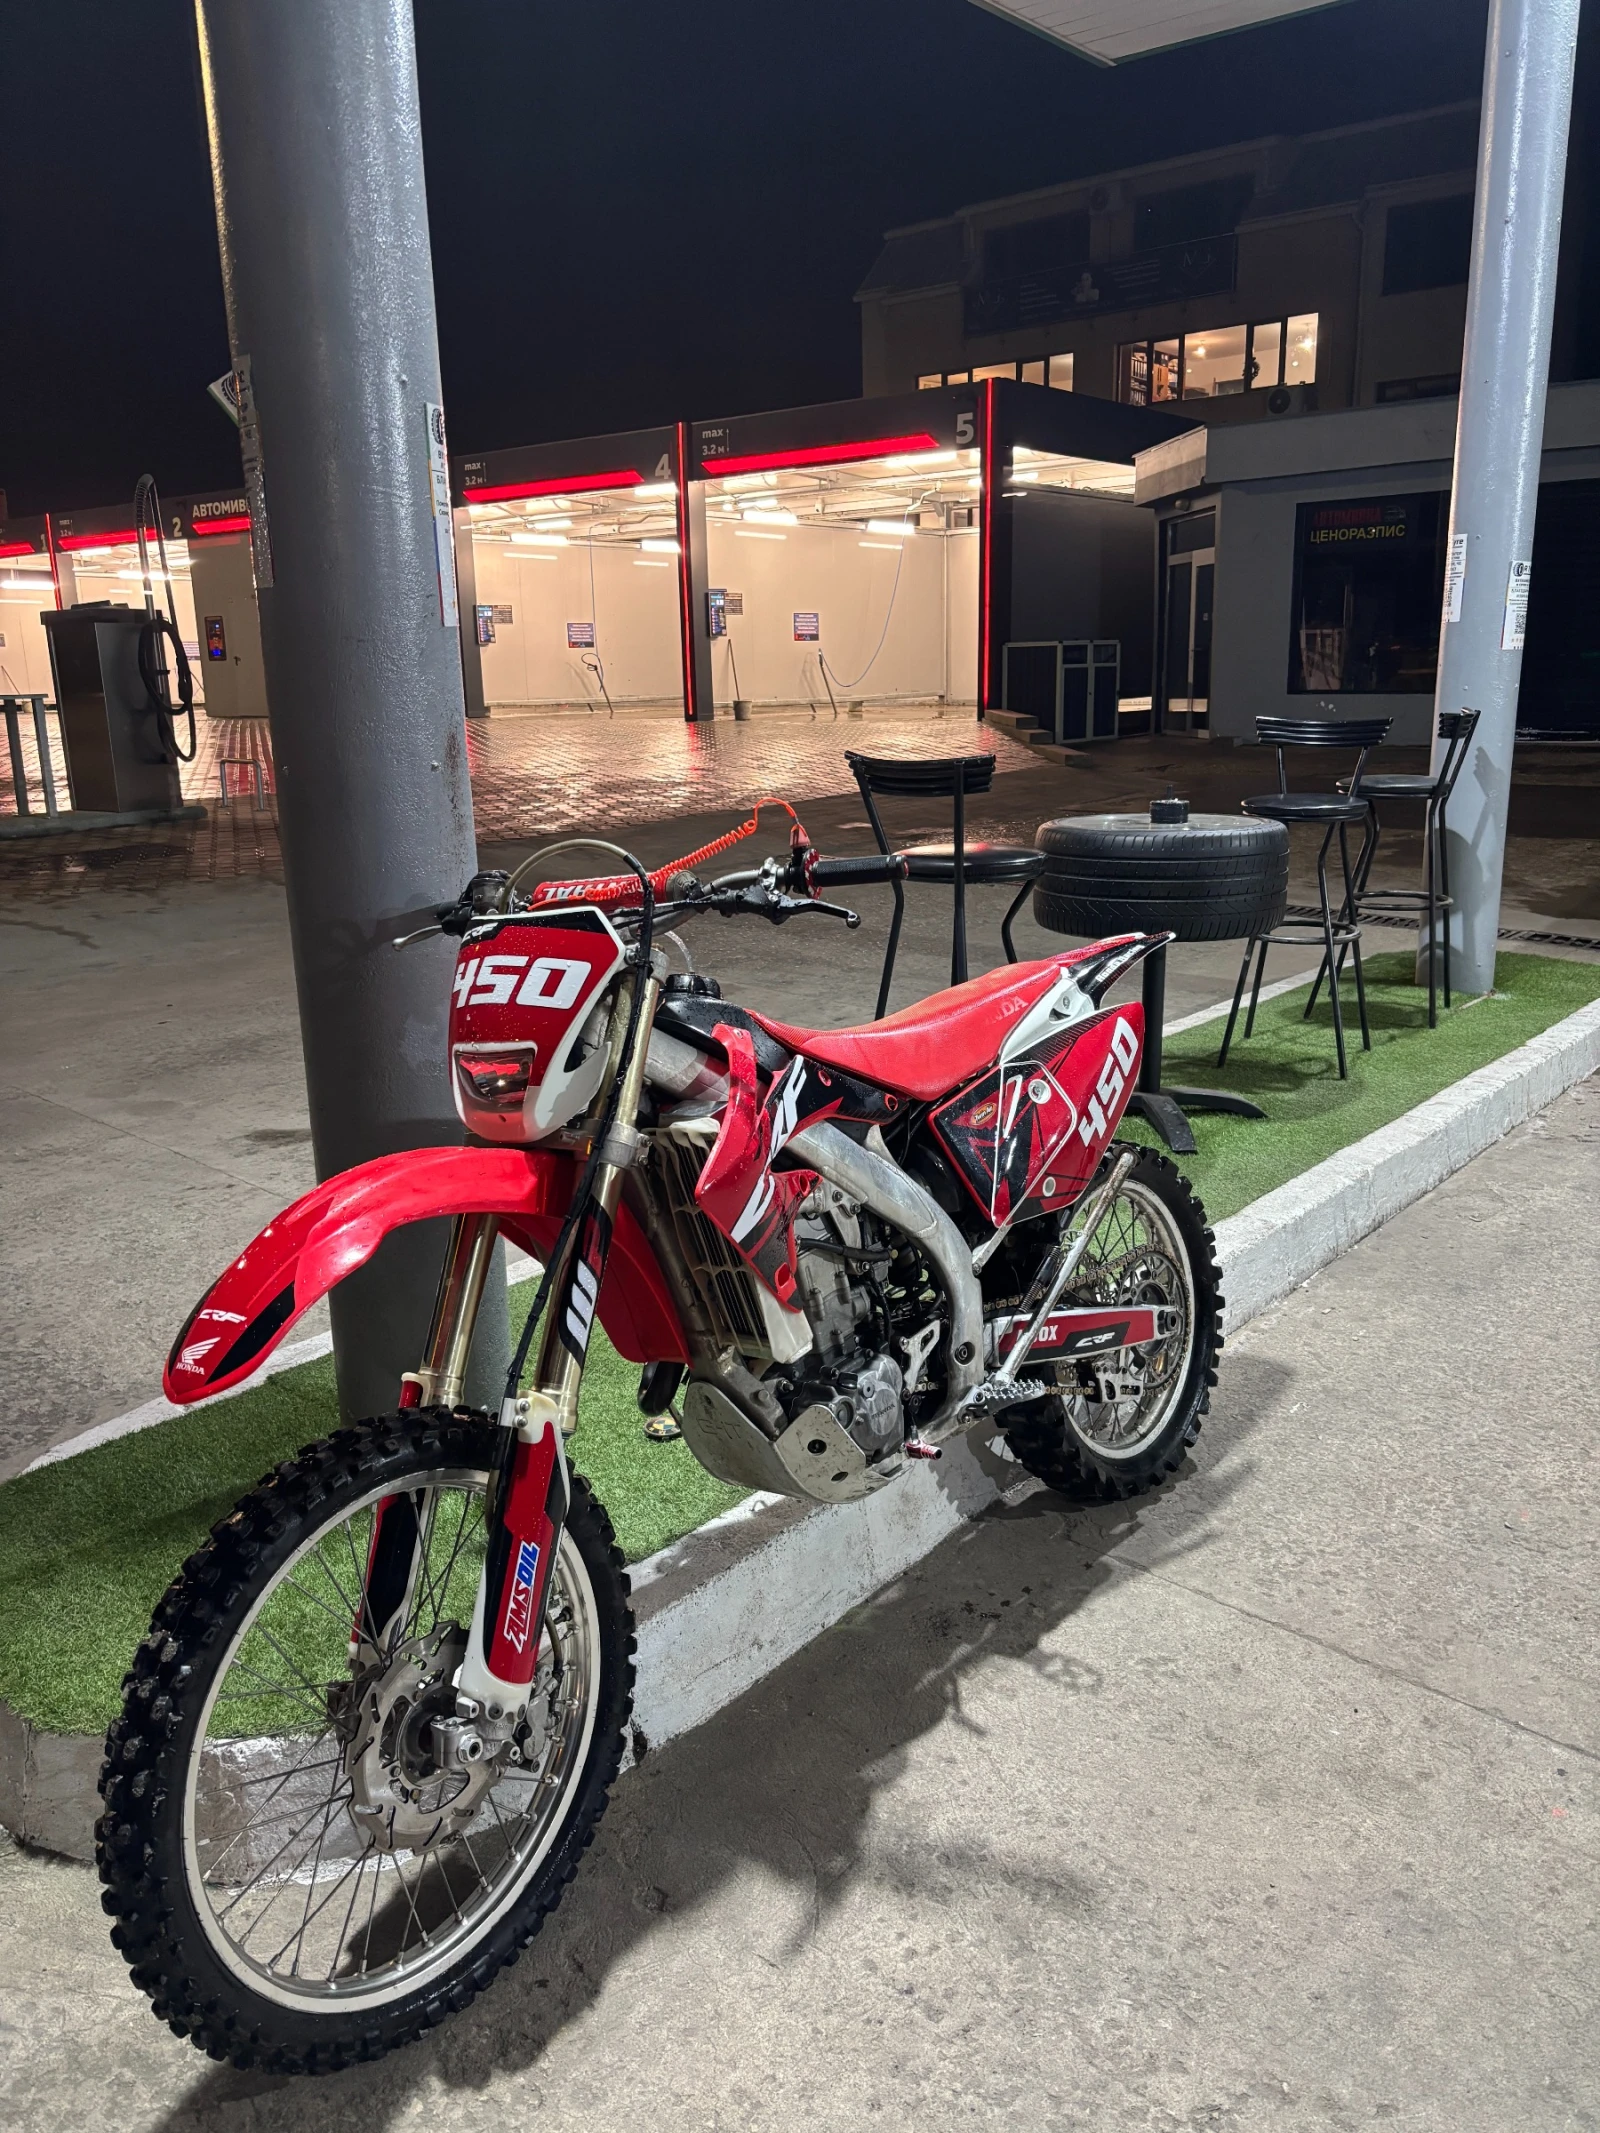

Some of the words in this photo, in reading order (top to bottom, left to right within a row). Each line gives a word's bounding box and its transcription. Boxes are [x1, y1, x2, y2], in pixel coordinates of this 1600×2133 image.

[702, 429, 724, 439] max
[955, 411, 974, 444] 5
[702, 444, 717, 456] 3.2
[464, 462, 481, 471] max
[655, 453, 671, 480] 4
[464, 475, 477, 486] 3.2
[192, 498, 249, 518] АВТОМИВ
[171, 516, 183, 538] 2
[1309, 524, 1406, 544] ЦЕНОРАЗПИС
[40, 533, 48, 552] 1
[461, 922, 499, 944] CRF
[452, 954, 592, 1010] 450
[1078, 1016, 1139, 1147] 450
[198, 1308, 248, 1324] CRF
[1075, 1331, 1116, 1348] CRF
[175, 1362, 206, 1376] HONDA
[503, 1540, 541, 1655] AMSOIL
